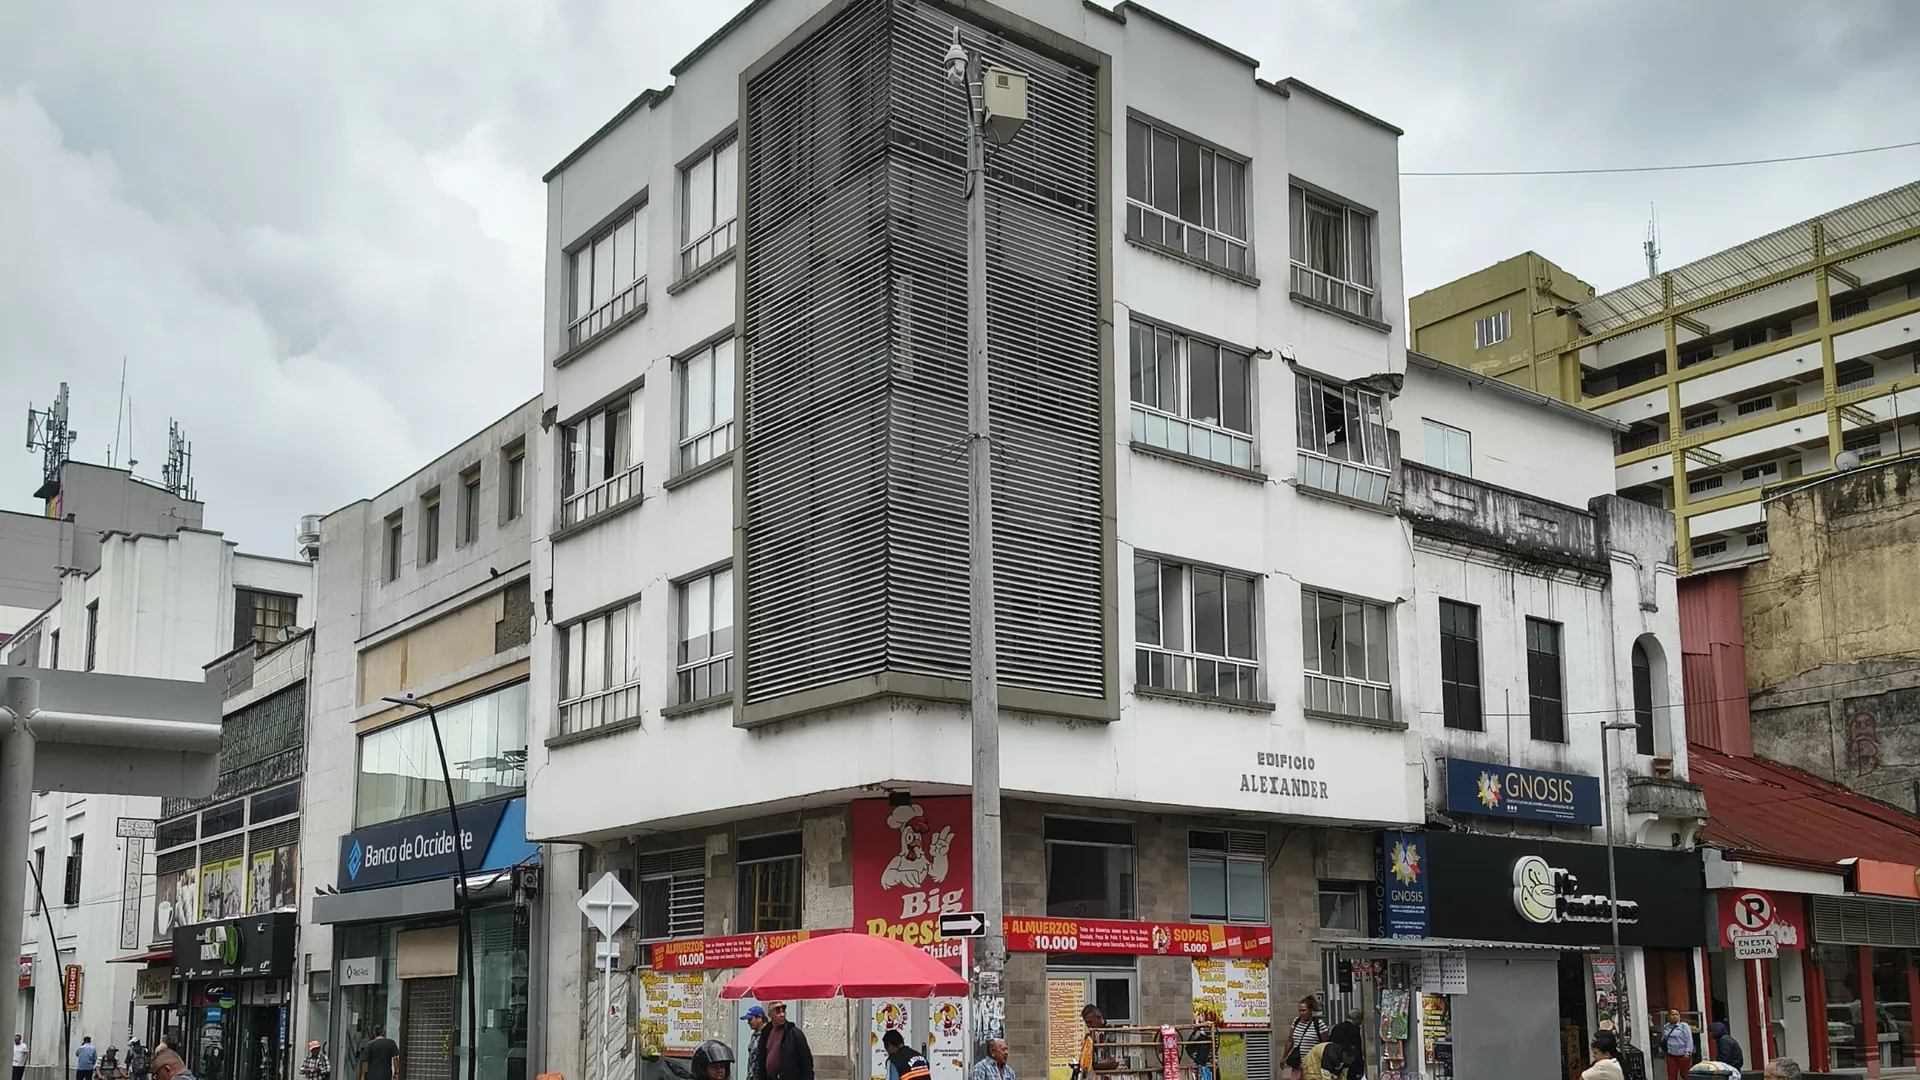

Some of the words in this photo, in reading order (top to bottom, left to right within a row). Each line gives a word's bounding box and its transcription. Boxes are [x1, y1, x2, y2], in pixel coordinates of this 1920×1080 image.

[1257, 752, 1315, 770] EDIFICIO
[1240, 774, 1328, 799] ALEXANDER
[1505, 772, 1574, 803] GNOSIS
[365, 845, 396, 868] Banco
[399, 838, 413, 861] de
[1391, 889, 1424, 902] GNOSIS
[900, 888, 964, 919] Big
[1012, 920, 1078, 935] ALMUERZOS
[769, 934, 797, 949] SOPAS
[1028, 935, 1078, 950] $10.000
[1173, 928, 1209, 943] SOPAS
[665, 940, 704, 955] ALMUERZOS
